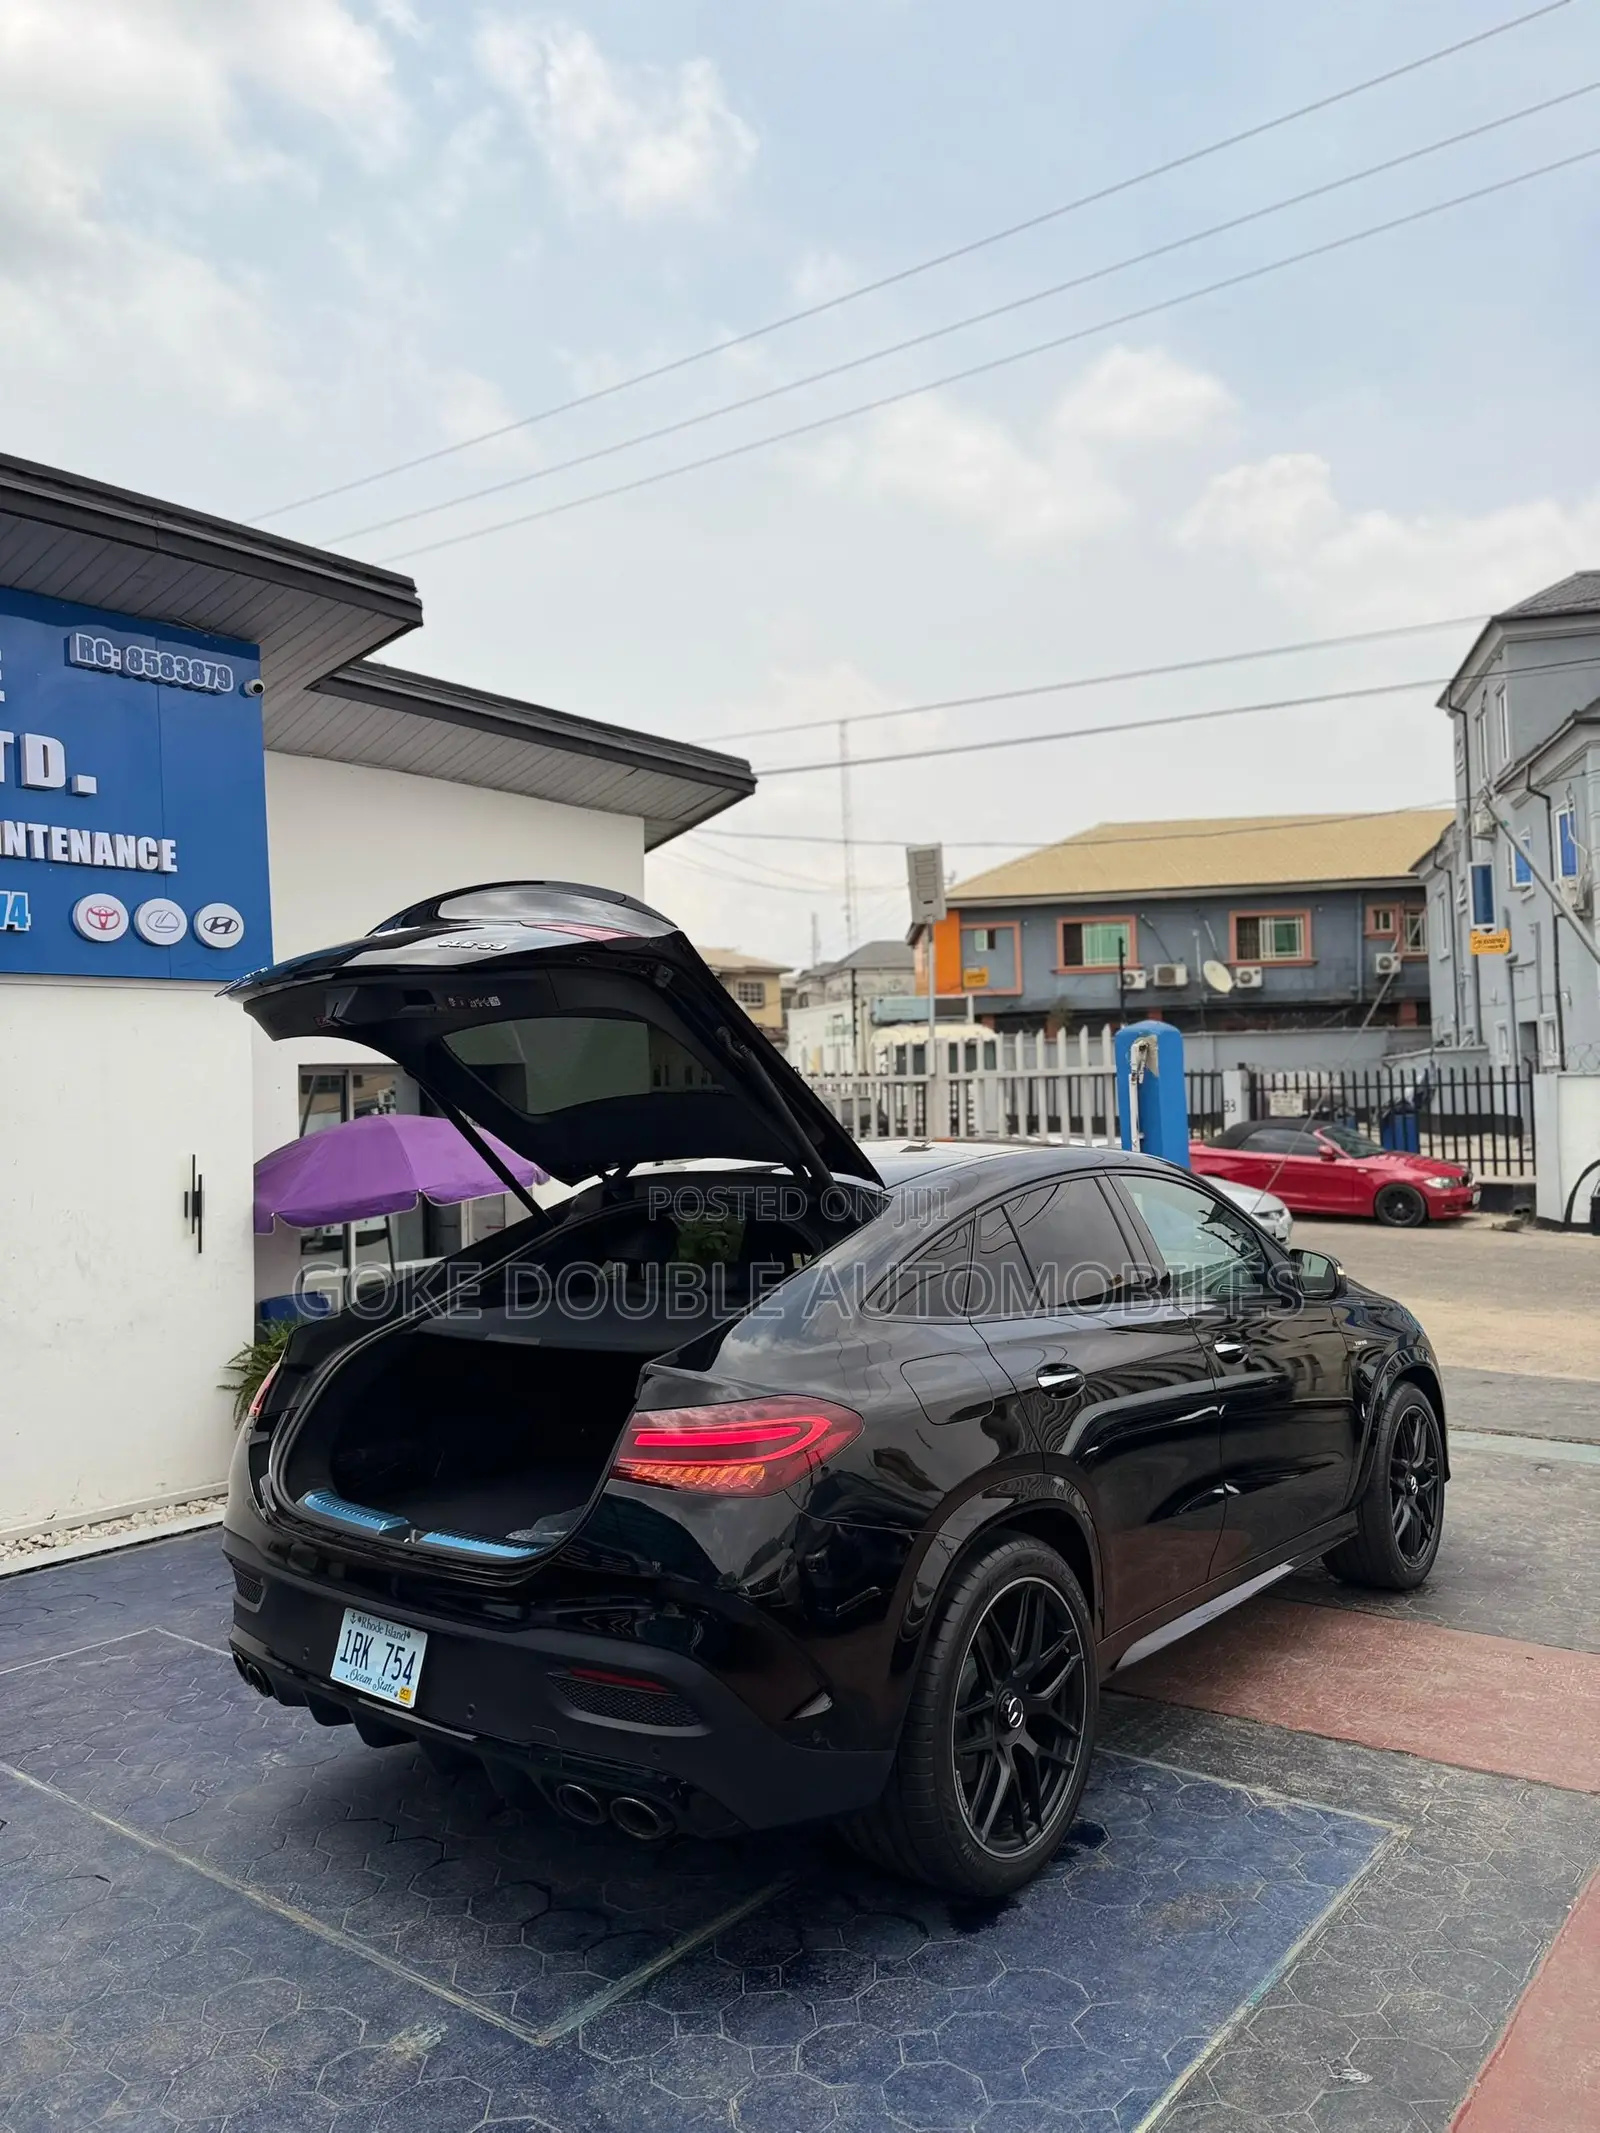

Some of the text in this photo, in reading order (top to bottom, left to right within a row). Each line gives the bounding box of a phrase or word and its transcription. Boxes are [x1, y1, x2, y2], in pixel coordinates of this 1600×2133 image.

[73, 632, 234, 693] RC: 8583879
[0, 819, 178, 873] NTENANCE
[360, 1616, 407, 1642] Rhode Island
[339, 1629, 417, 1686] 1RK 754
[349, 1668, 396, 1694] Ocean State
